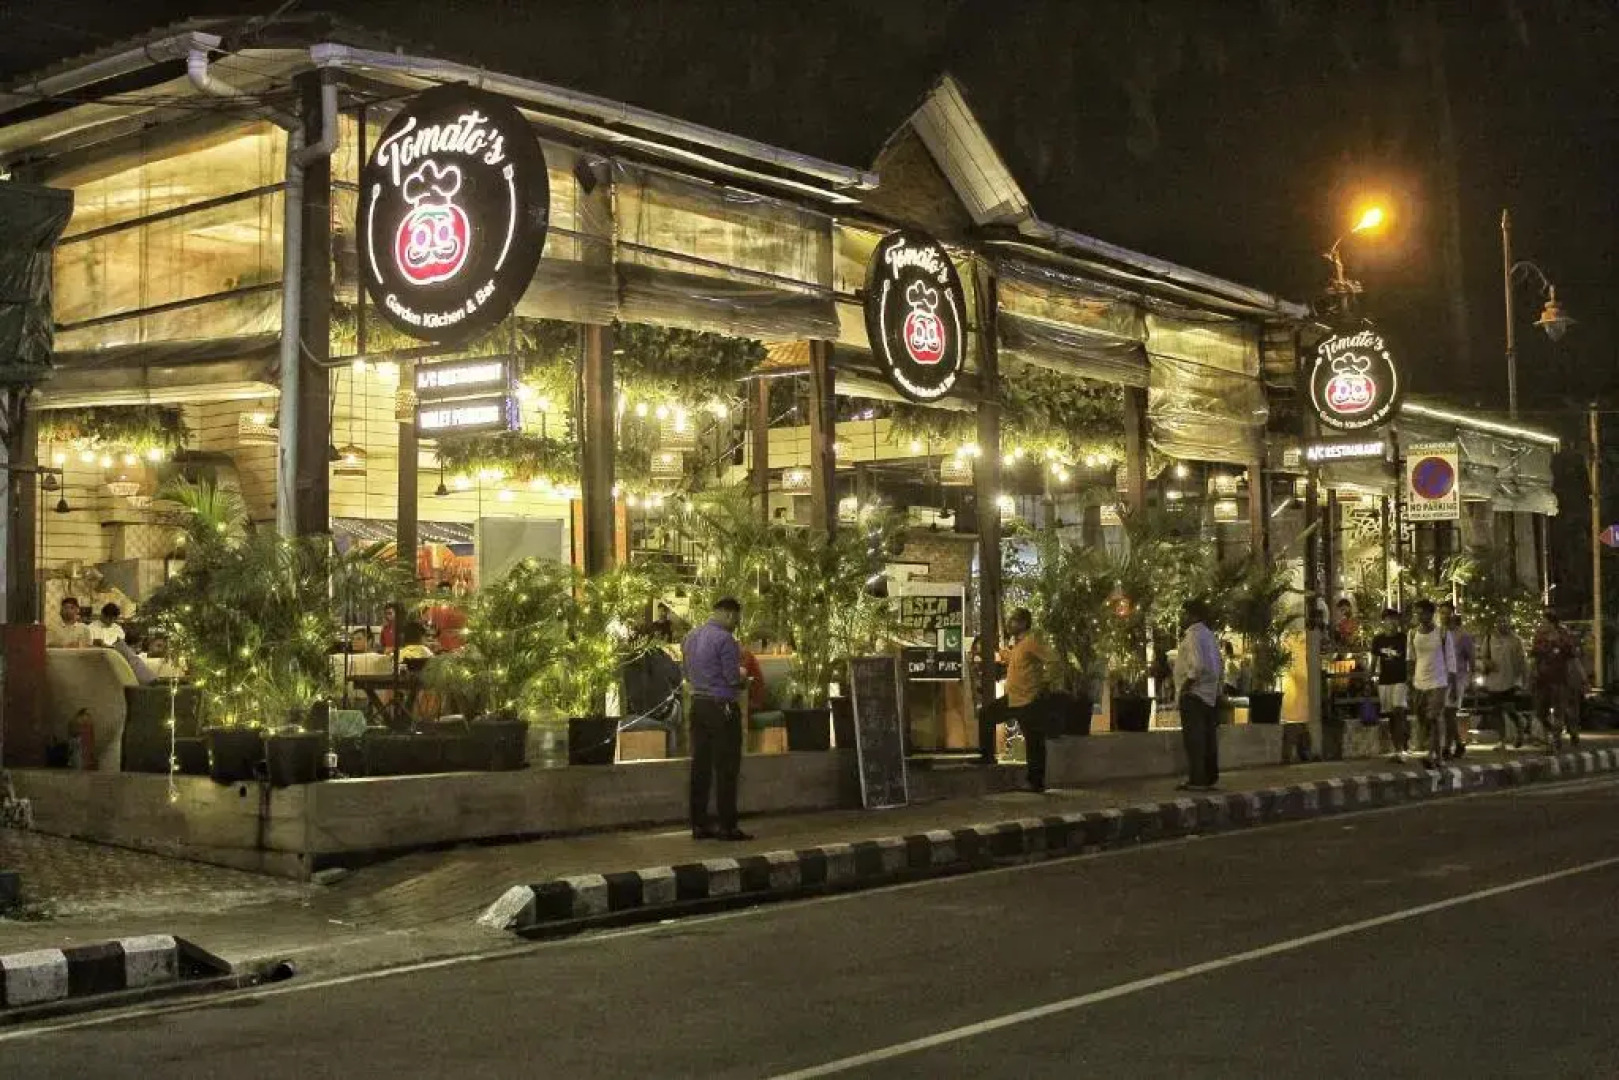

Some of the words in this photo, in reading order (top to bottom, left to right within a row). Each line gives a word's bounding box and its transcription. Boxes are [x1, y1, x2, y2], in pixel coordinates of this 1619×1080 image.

[377, 110, 505, 187] Tomato's
[885, 237, 949, 284] Tomato's
[386, 293, 421, 326] Garden
[423, 307, 466, 328] Kitchen
[466, 299, 477, 314] &
[475, 279, 496, 306] Bar
[1318, 330, 1384, 361] Tomato's
[1325, 441, 1385, 458] RESTAURANT
[1410, 503, 1422, 513] NO
[1423, 502, 1457, 512] PARKING
